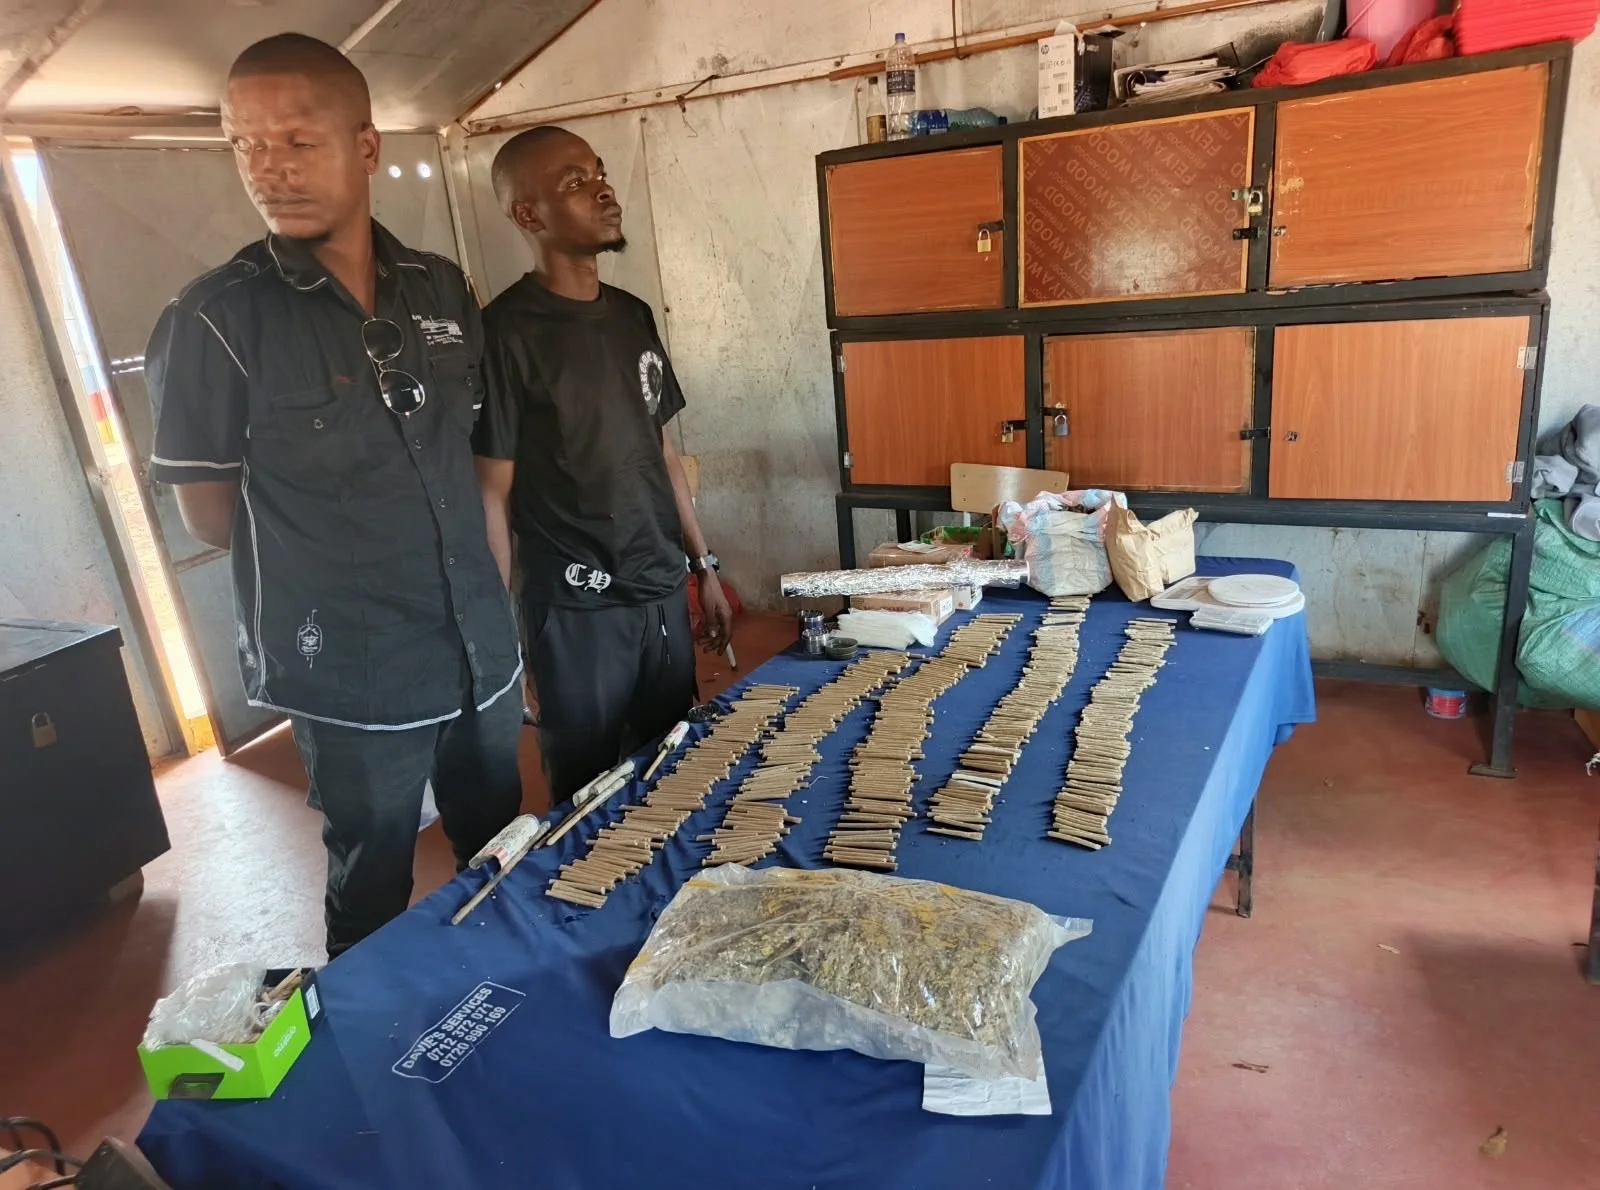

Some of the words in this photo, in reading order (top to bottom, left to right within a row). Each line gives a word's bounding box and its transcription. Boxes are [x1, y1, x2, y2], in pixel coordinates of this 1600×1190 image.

[401, 1031, 446, 1069] DAVIE'S
[441, 987, 492, 1031] SERVICES
[426, 1037, 457, 1061] 0712
[452, 1019, 476, 1038] 372
[471, 1002, 494, 1020] 071
[440, 1042, 470, 1067] 0720
[465, 1024, 488, 1042] 990
[484, 1006, 506, 1023] 169
